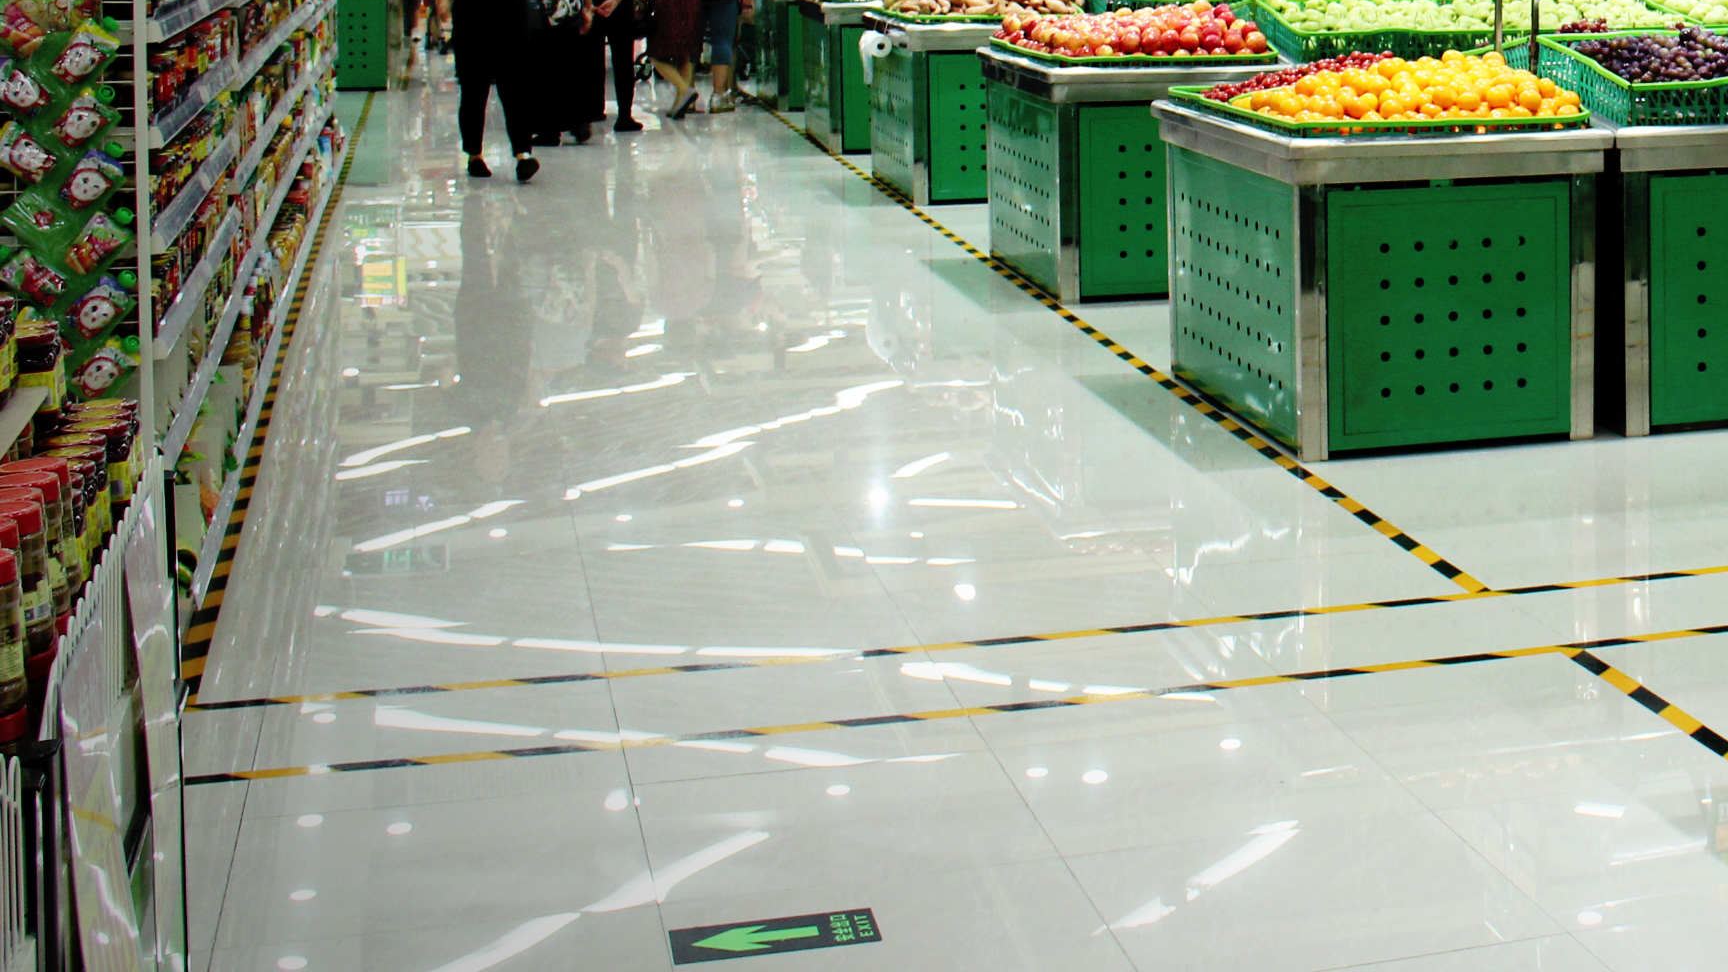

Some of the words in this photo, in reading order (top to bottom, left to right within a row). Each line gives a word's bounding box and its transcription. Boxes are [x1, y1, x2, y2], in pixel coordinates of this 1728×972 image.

[830, 914, 855, 942] 安全出口
[854, 914, 874, 938] EXIT
